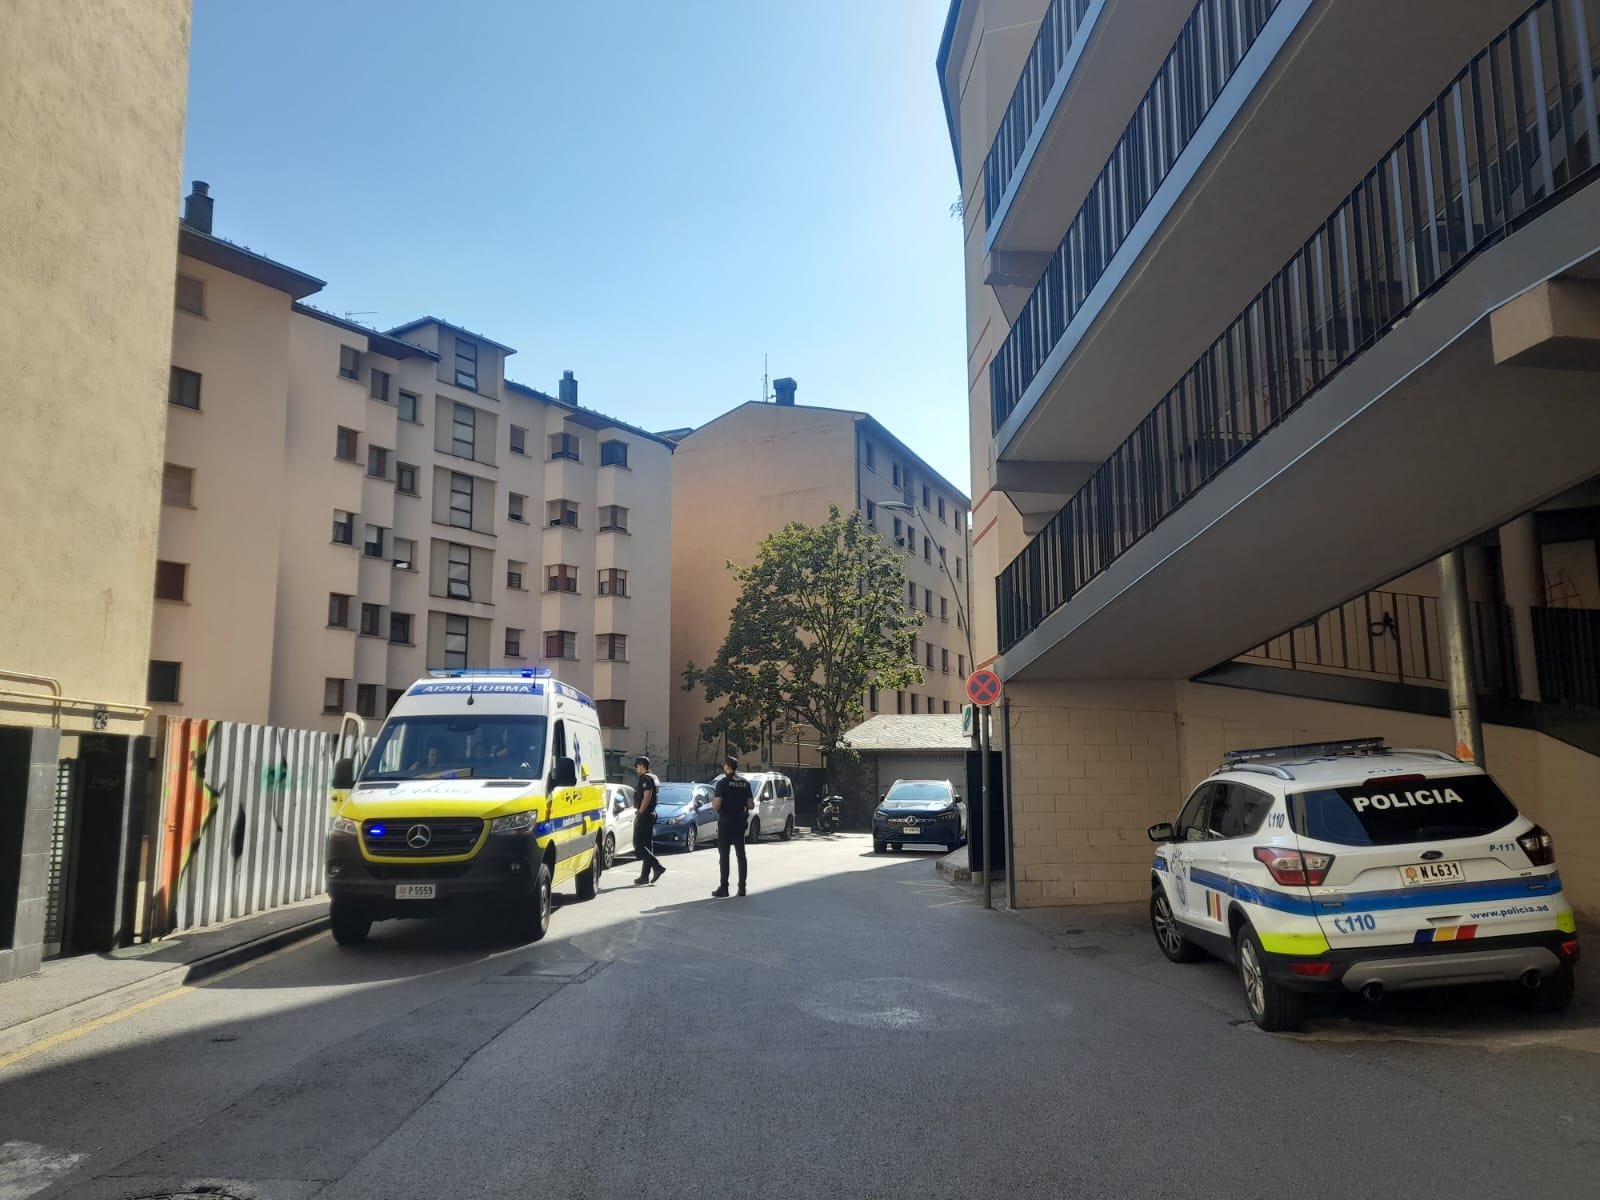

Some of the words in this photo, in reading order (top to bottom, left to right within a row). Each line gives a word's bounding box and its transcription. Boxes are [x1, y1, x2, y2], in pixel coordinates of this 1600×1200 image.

[1352, 788, 1464, 812] POLICIA
[1272, 812, 1286, 829] 110
[1430, 863, 1460, 878] 4631
[414, 886, 433, 895] 5559
[1470, 904, 1550, 919] www.policia.ad
[1345, 914, 1376, 932] 110
